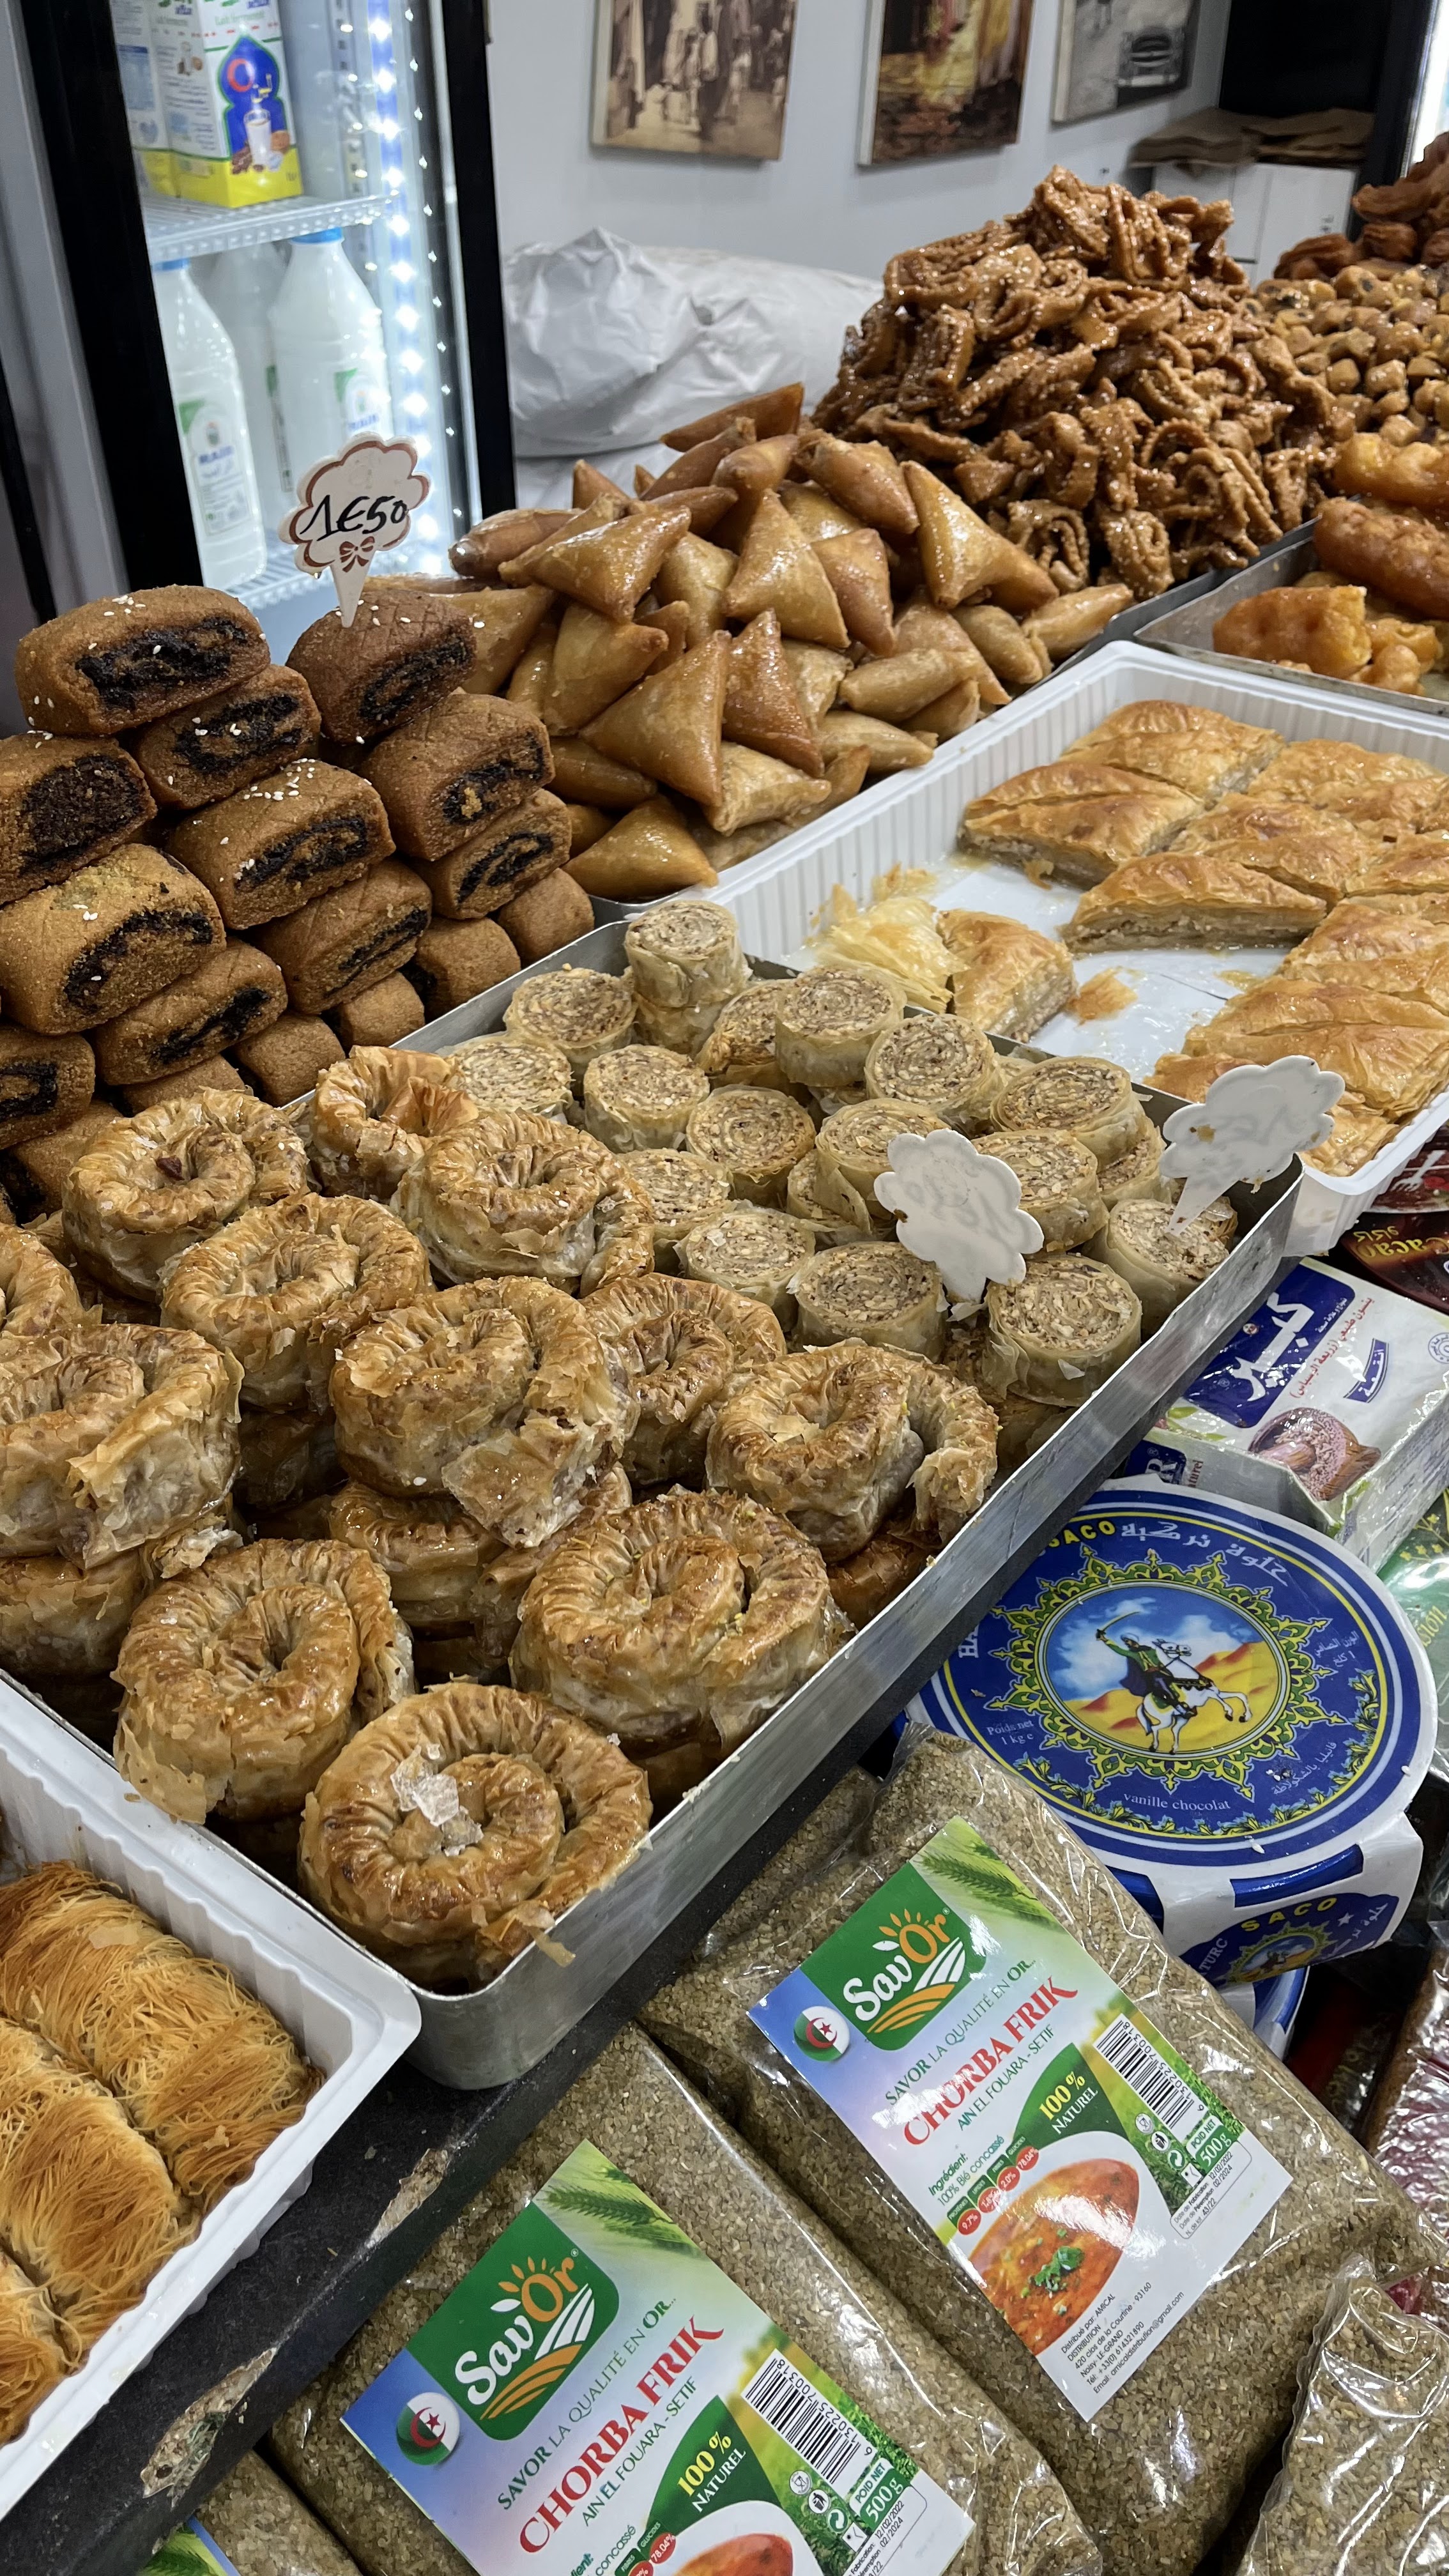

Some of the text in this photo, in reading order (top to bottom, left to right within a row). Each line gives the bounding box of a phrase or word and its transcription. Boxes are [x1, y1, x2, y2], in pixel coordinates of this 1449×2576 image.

[987, 1720, 1034, 1736] Poids net
[1010, 1734, 1026, 1747] kg
[1124, 1791, 1231, 1812] vanille chocolat
[1241, 1897, 1338, 1932] SACO
[885, 2058, 931, 2105] SAVOR
[928, 2044, 947, 2062] LA
[944, 1993, 995, 2046] QUALITÉ
[991, 1979, 1010, 1999] EN
[902, 1975, 1078, 2146] CHORBA FRIK
[1121, 2021, 1159, 2059] 700318
[956, 2108, 977, 2131] AIN
[972, 2096, 990, 2112] EL
[985, 2055, 1028, 2099] FOUARA
[1027, 2024, 1055, 2054] SETIF
[1037, 2070, 1085, 2120] 100 %
[1156, 2062, 1195, 2099] 130225
[1052, 2087, 1098, 2134] NATUREL
[1190, 2119, 1216, 2148] POID NET
[928, 2152, 969, 2195] Ingrédient:
[937, 2135, 1005, 2206] 100% Blé concassé
[962, 2212, 978, 2229] 9.7%
[1000, 2172, 1016, 2188] 2.0%
[1017, 2147, 1040, 2170] 78.04%
[1208, 2151, 1233, 2179] 12/02/2022
[1061, 2294, 1115, 2353] Distribué par: AMICAL
[1068, 2324, 1101, 2361] DISTRIBUTION
[1075, 2356, 1086, 2369] 420
[1085, 2343, 1098, 2358] clos
[1095, 2334, 1107, 2345] de
[1103, 2328, 1112, 2336] la
[1110, 2304, 1133, 2329] Courtine
[1134, 2282, 1151, 2301] 93160
[1093, 2292, 1184, 2393] Email: amicaldistribution@gmail.com
[1096, 2329, 1123, 2359] LE-GRAND
[1115, 2321, 1144, 2354] 614321890
[496, 2446, 552, 2510] SAVOR
[548, 2424, 571, 2448] LA
[567, 2350, 627, 2423] QUALITÉ
[623, 2328, 646, 2354] EN
[776, 2359, 872, 2455] 6 130225 700318
[517, 2315, 724, 2554] CHORBA FRIK
[581, 2495, 606, 2526] AIN
[599, 2479, 620, 2499] EL
[615, 2421, 666, 2480] FOUARA
[665, 2376, 698, 2416] SETIF
[677, 2430, 732, 2496] 100 %
[692, 2448, 746, 2511] NATUREL
[855, 2462, 887, 2503] POID NET
[640, 2522, 661, 2547] GLUCIDES
[650, 2533, 677, 2561] 78.04%
[850, 2500, 905, 2574] Fabrication: 12/02/2022
